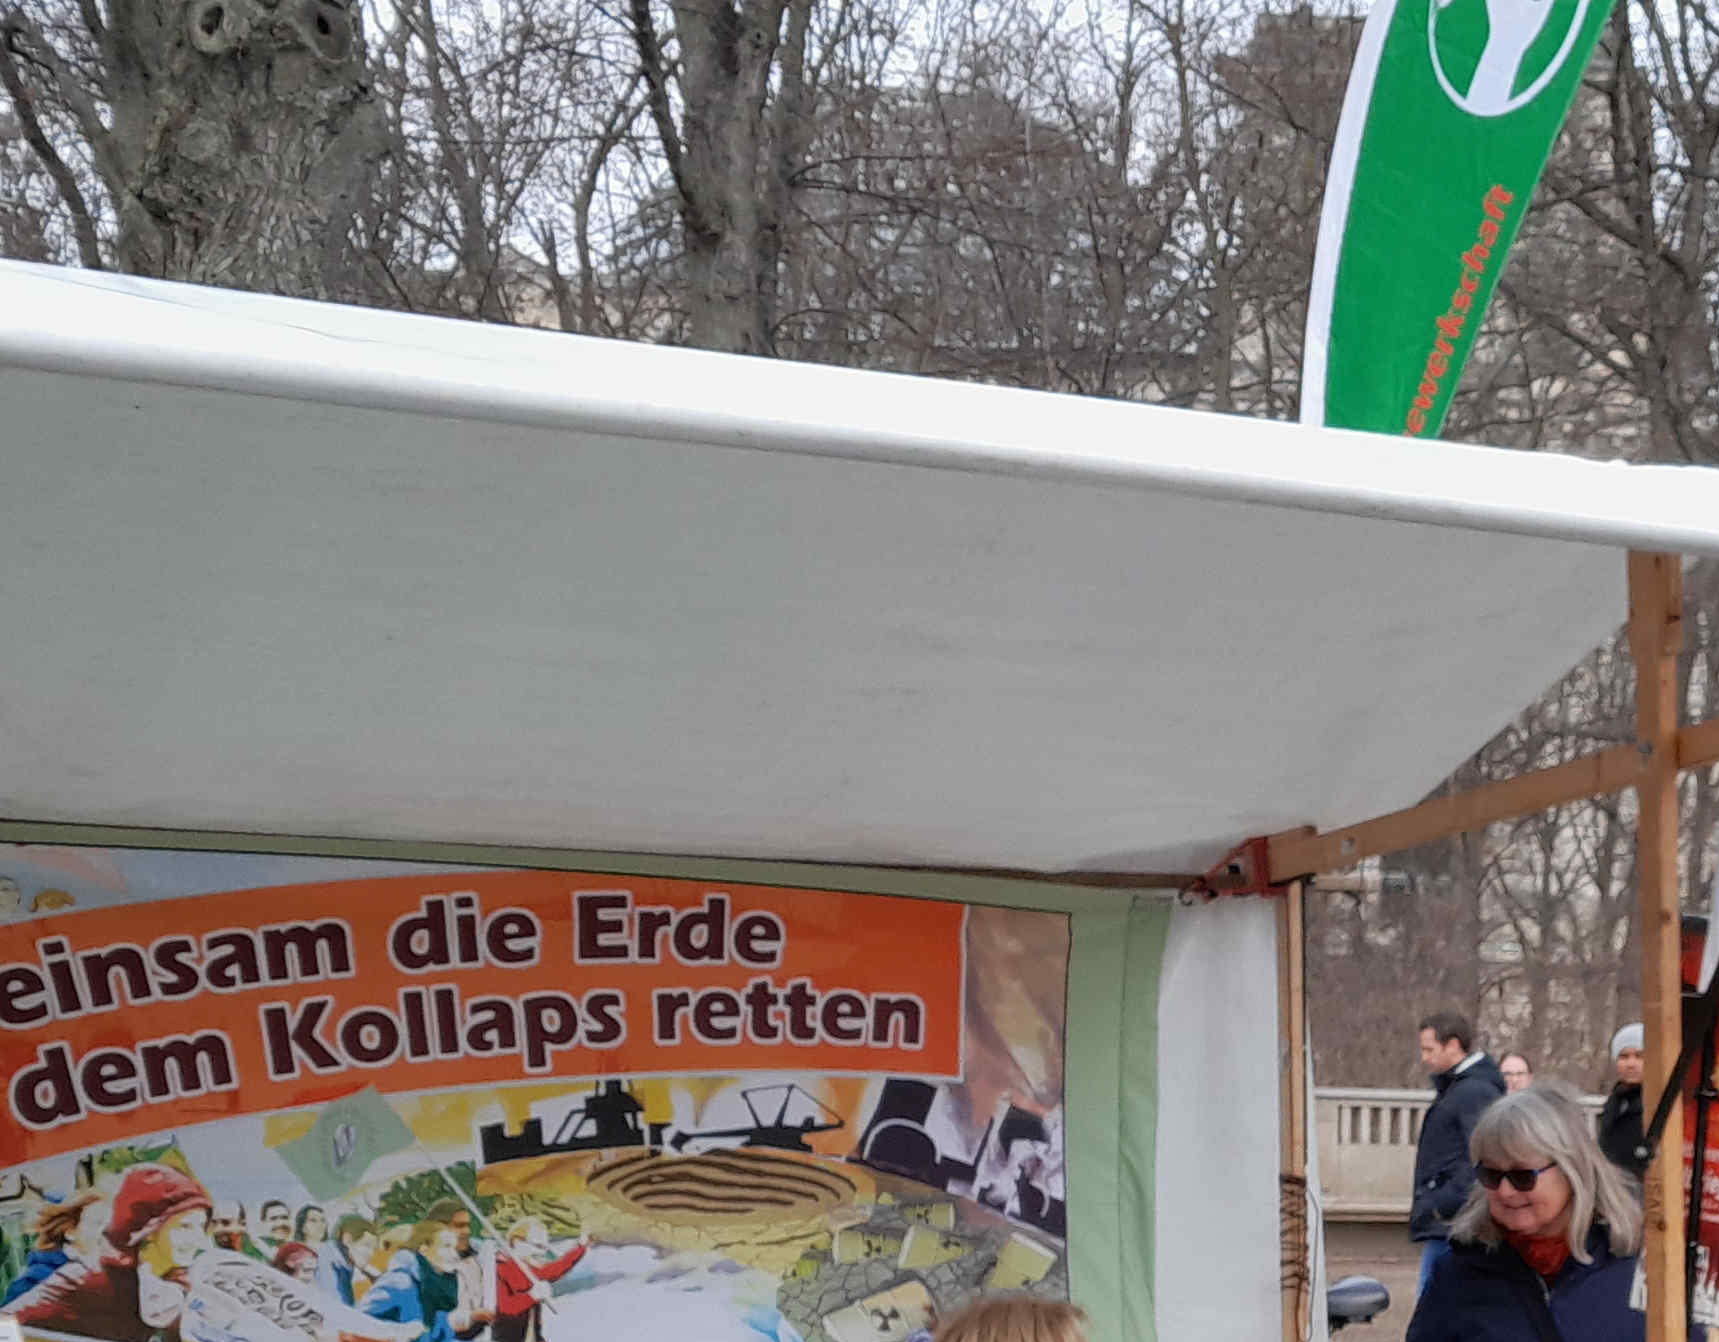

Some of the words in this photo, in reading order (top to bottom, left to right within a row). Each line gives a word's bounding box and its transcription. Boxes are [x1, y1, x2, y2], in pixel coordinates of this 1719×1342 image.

[1403, 184, 1514, 437] ewerkschaft
[0, 921, 351, 1024] einsam
[392, 896, 538, 967] die
[576, 896, 781, 963] Erde
[14, 1032, 233, 1124] dem
[262, 986, 624, 1075] Kollaps
[656, 982, 920, 1044] retten
